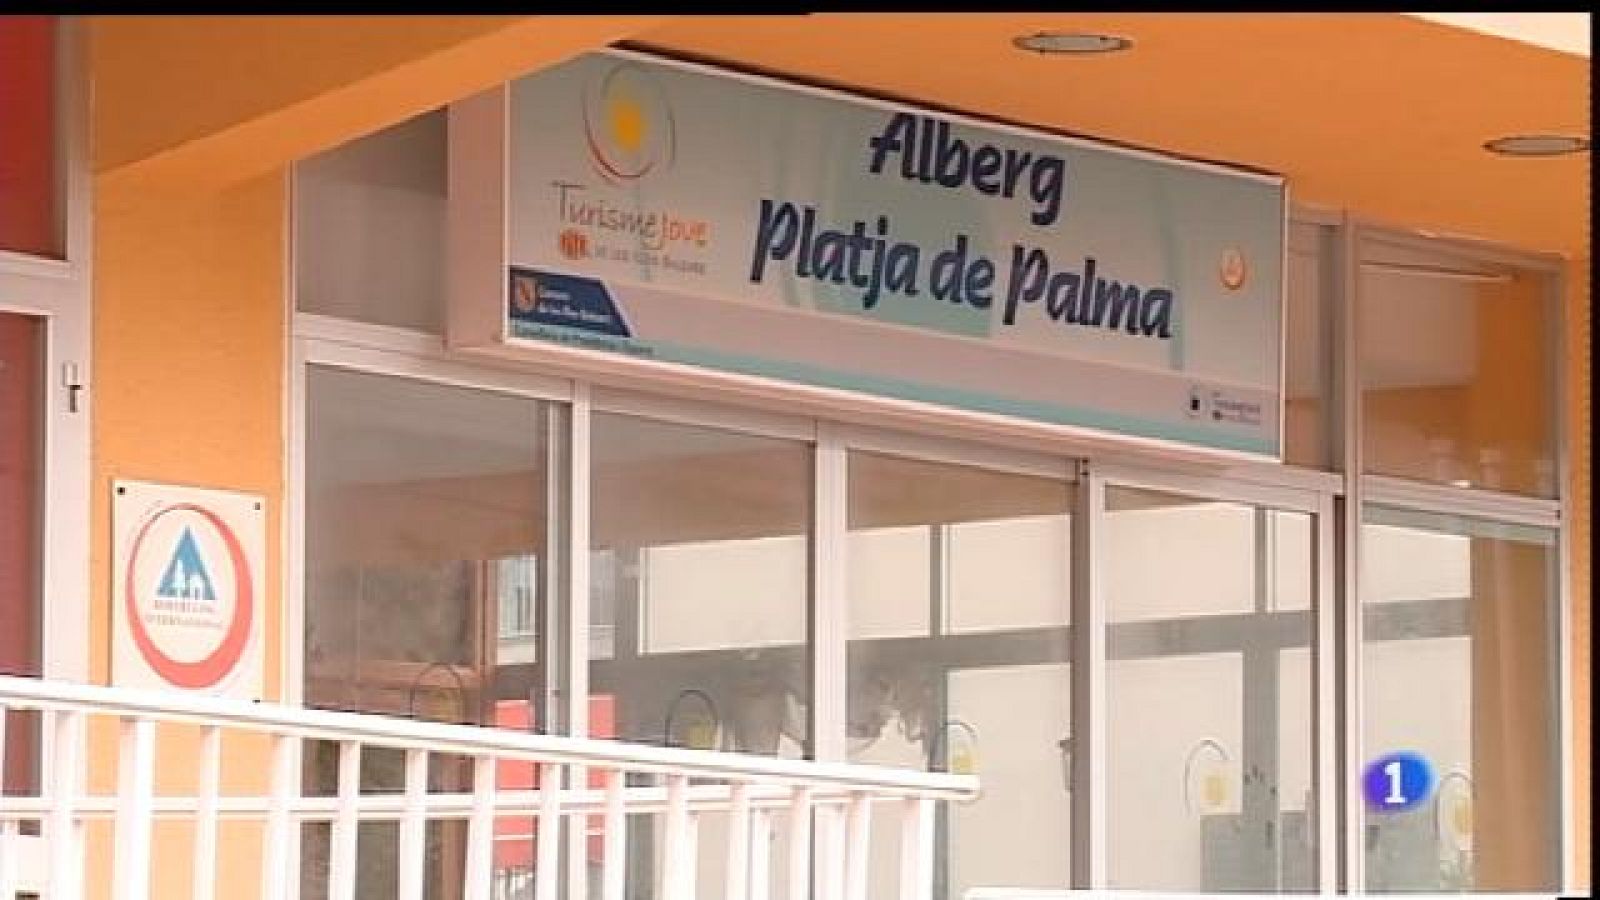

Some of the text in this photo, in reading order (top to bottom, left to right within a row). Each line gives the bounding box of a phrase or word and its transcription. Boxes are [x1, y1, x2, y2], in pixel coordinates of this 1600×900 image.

[869, 112, 1066, 226] Alberg
[749, 199, 1174, 339] Platja de Palma
